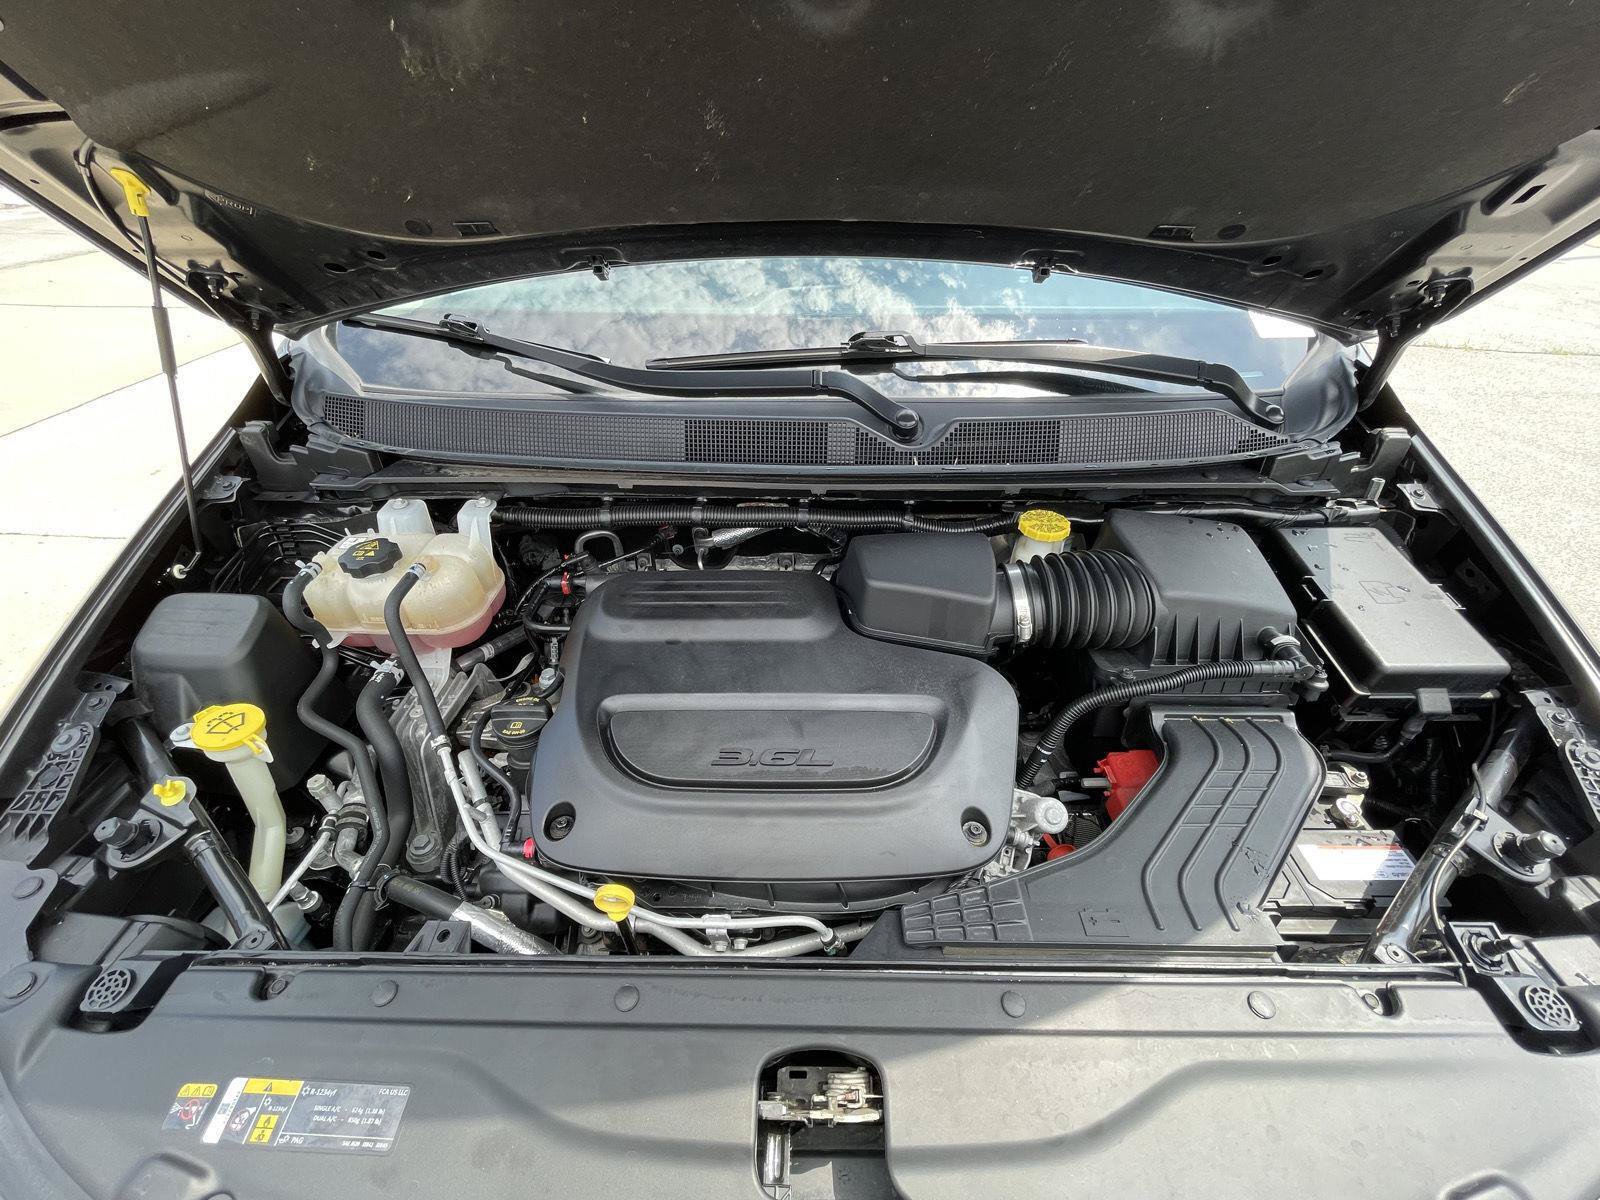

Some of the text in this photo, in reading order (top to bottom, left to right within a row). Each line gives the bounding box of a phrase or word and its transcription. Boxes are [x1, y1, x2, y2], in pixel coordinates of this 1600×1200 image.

[711, 748, 834, 767] 3.6L
[331, 1105, 341, 1113] A/C
[290, 1137, 304, 1145] PAG
